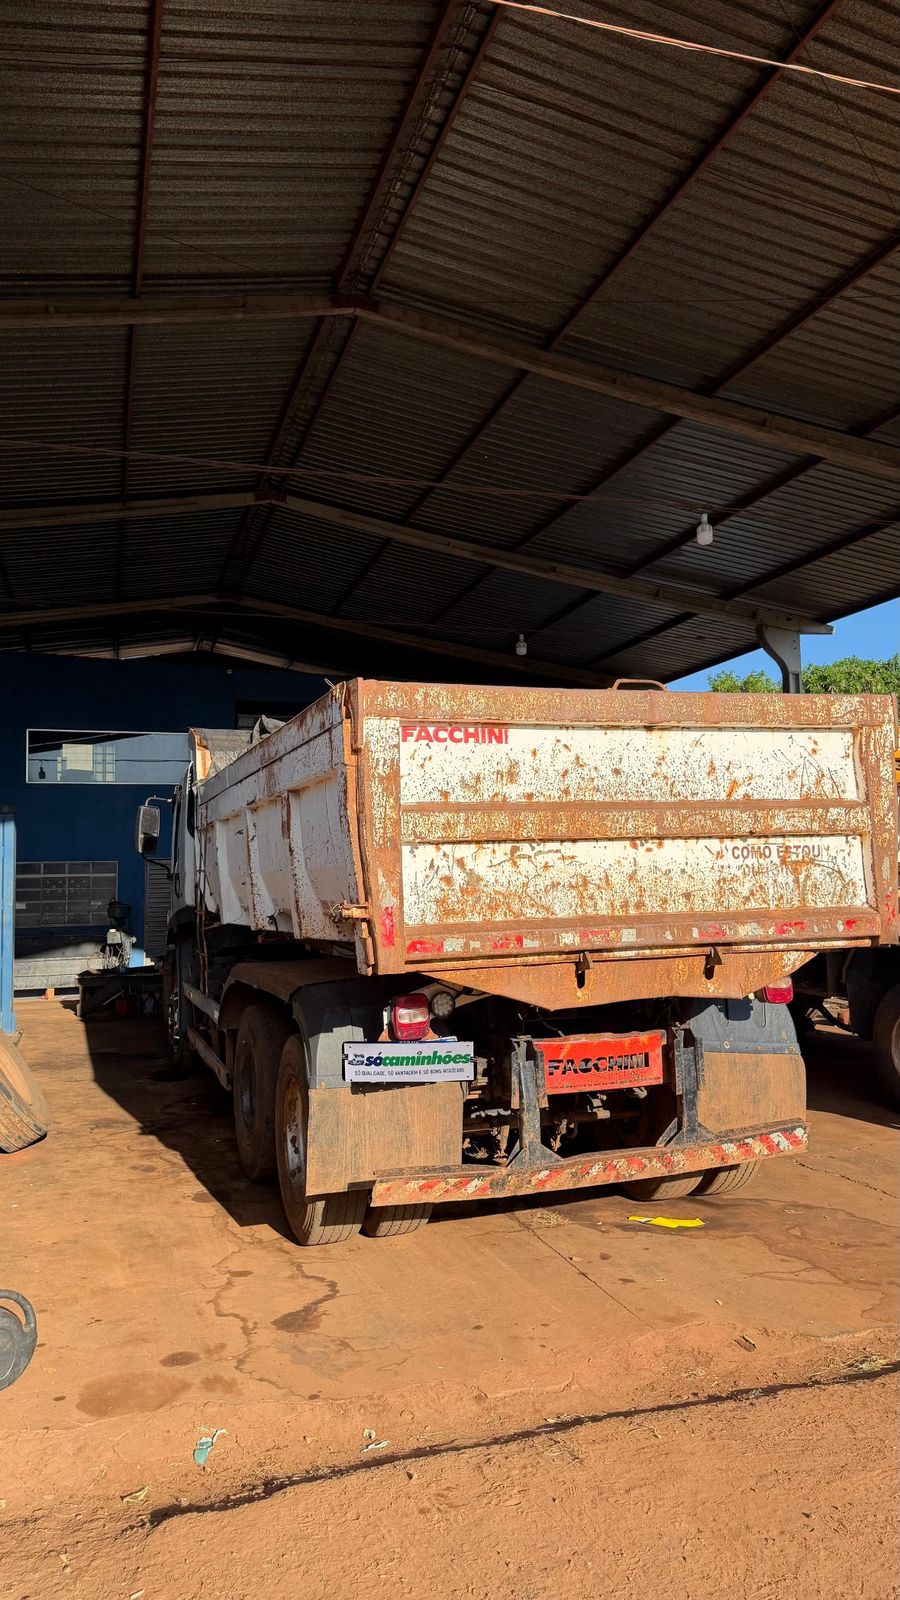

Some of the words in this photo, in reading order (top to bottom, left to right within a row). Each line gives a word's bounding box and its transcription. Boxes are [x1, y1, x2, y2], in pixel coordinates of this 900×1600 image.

[401, 726, 509, 744] FACCHINI
[731, 845, 772, 859] COMO
[548, 1052, 649, 1076] FACCHINI
